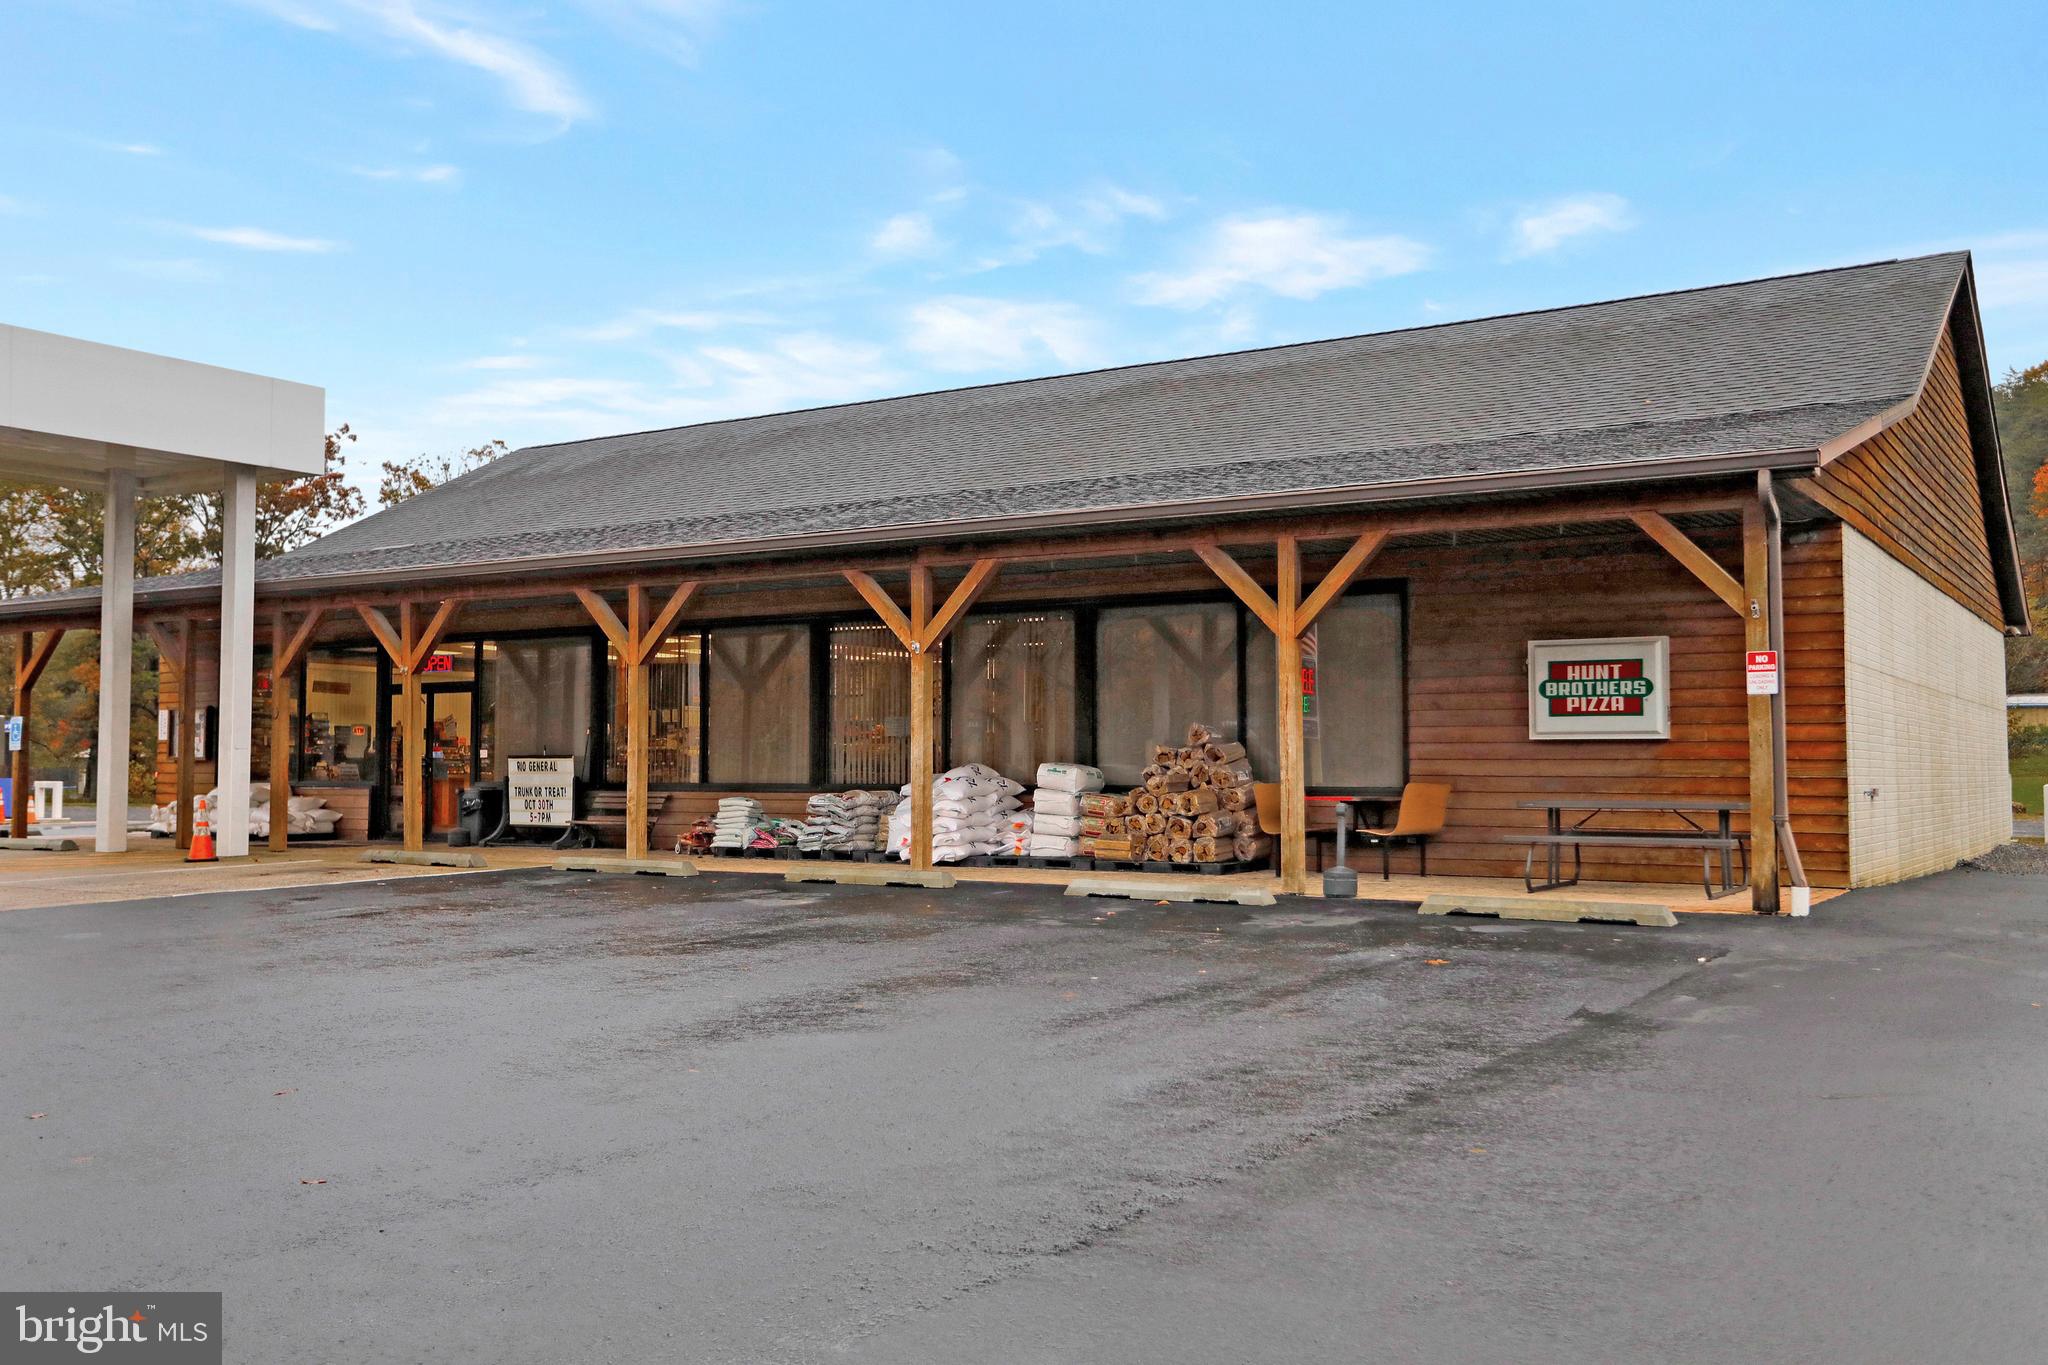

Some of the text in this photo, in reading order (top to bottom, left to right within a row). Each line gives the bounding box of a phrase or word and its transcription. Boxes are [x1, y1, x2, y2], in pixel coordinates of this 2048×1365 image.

[1566, 664, 1622, 680] HUNT
[1545, 680, 1646, 696] BROTHERS
[1566, 696, 1624, 712] PIZZA
[516, 761, 558, 772] RIO GENERAL
[514, 787, 567, 797] TRUNK OR TREAT!
[524, 800, 554, 810] OCT 30TH
[530, 812, 551, 823] 5-7PM
